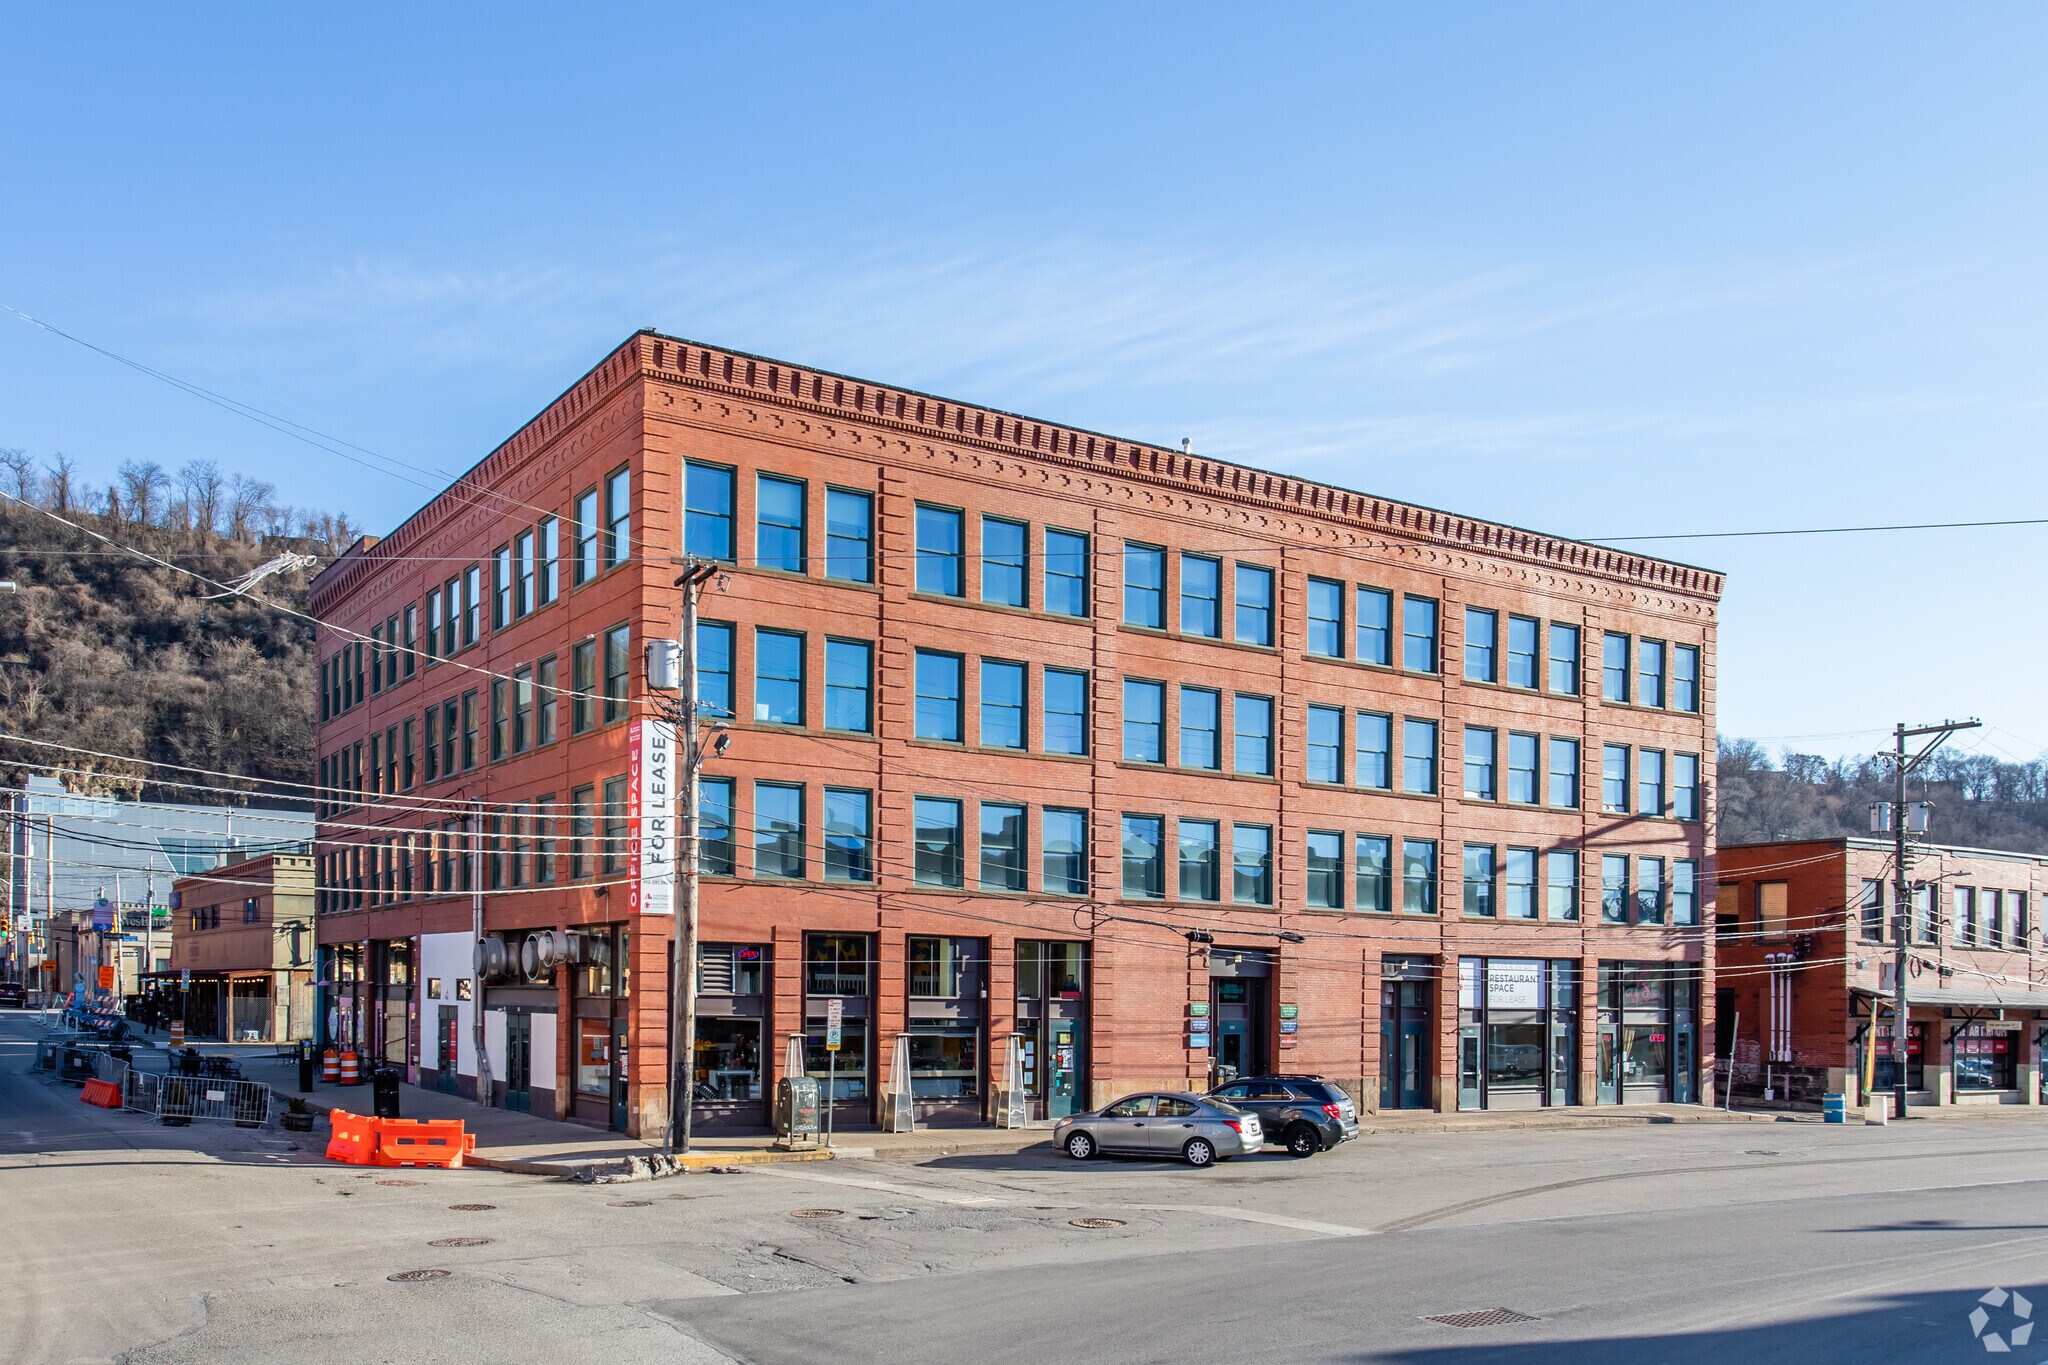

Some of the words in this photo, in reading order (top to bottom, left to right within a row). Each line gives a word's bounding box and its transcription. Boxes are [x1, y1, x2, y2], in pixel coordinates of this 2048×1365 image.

[651, 737, 666, 808] LEASE
[631, 749, 639, 817] SPACE
[651, 818, 666, 864] FOR
[630, 827, 638, 907] OFFICE
[120, 916, 172, 927] WesBnco
[1489, 974, 1541, 983] RESTAURANT
[1489, 984, 1514, 993] SPACE
[1490, 995, 1504, 1003] FOR
[1505, 995, 1527, 1003] LEASE
[1650, 1034, 1665, 1042] OPEN
